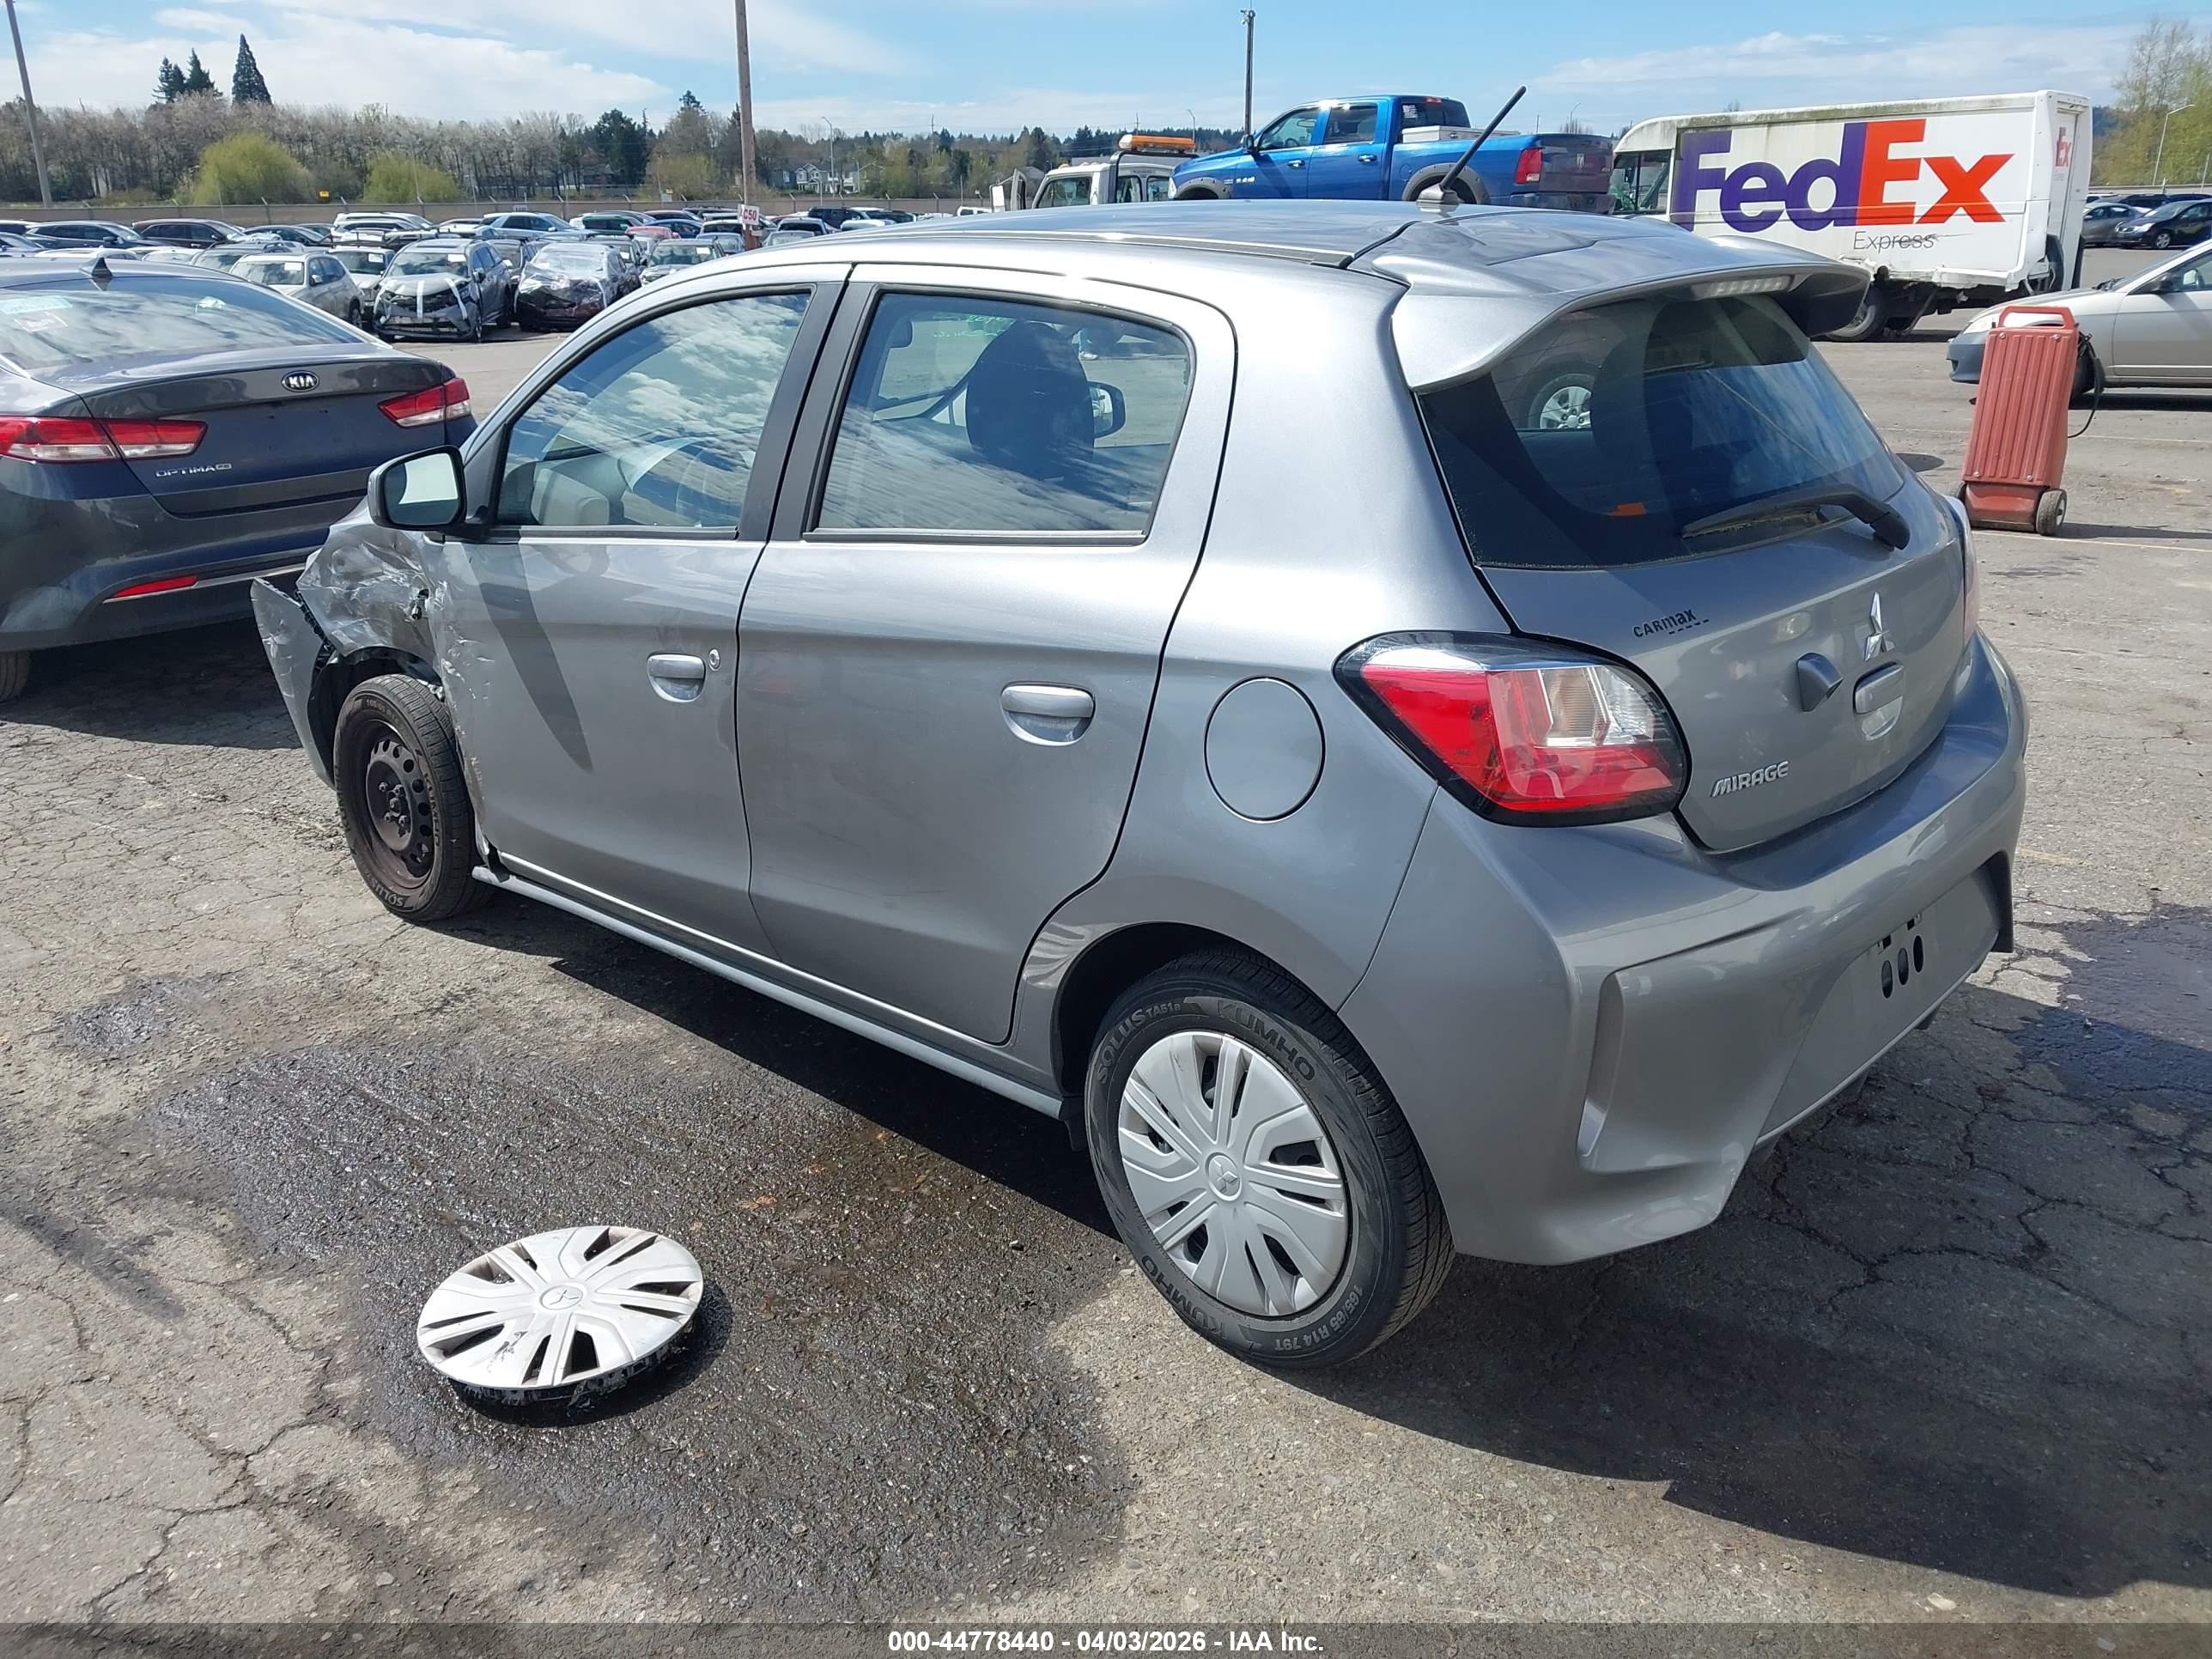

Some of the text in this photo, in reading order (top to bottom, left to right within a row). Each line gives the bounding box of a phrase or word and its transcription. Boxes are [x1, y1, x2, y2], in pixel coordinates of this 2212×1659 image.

[1670, 118, 2015, 232] FedEx
[1853, 230, 1935, 253] Express
[289, 376, 314, 388] KIA
[155, 465, 216, 477] OPTIMA
[1711, 761, 1790, 797] MIRAGE
[1097, 1007, 1146, 1084] SOLUS
[1218, 999, 1316, 1082] KUMHO
[1141, 1255, 1228, 1340] KUMHO
[1330, 1285, 1364, 1332] 165/65
[1303, 1324, 1330, 1346] R14
